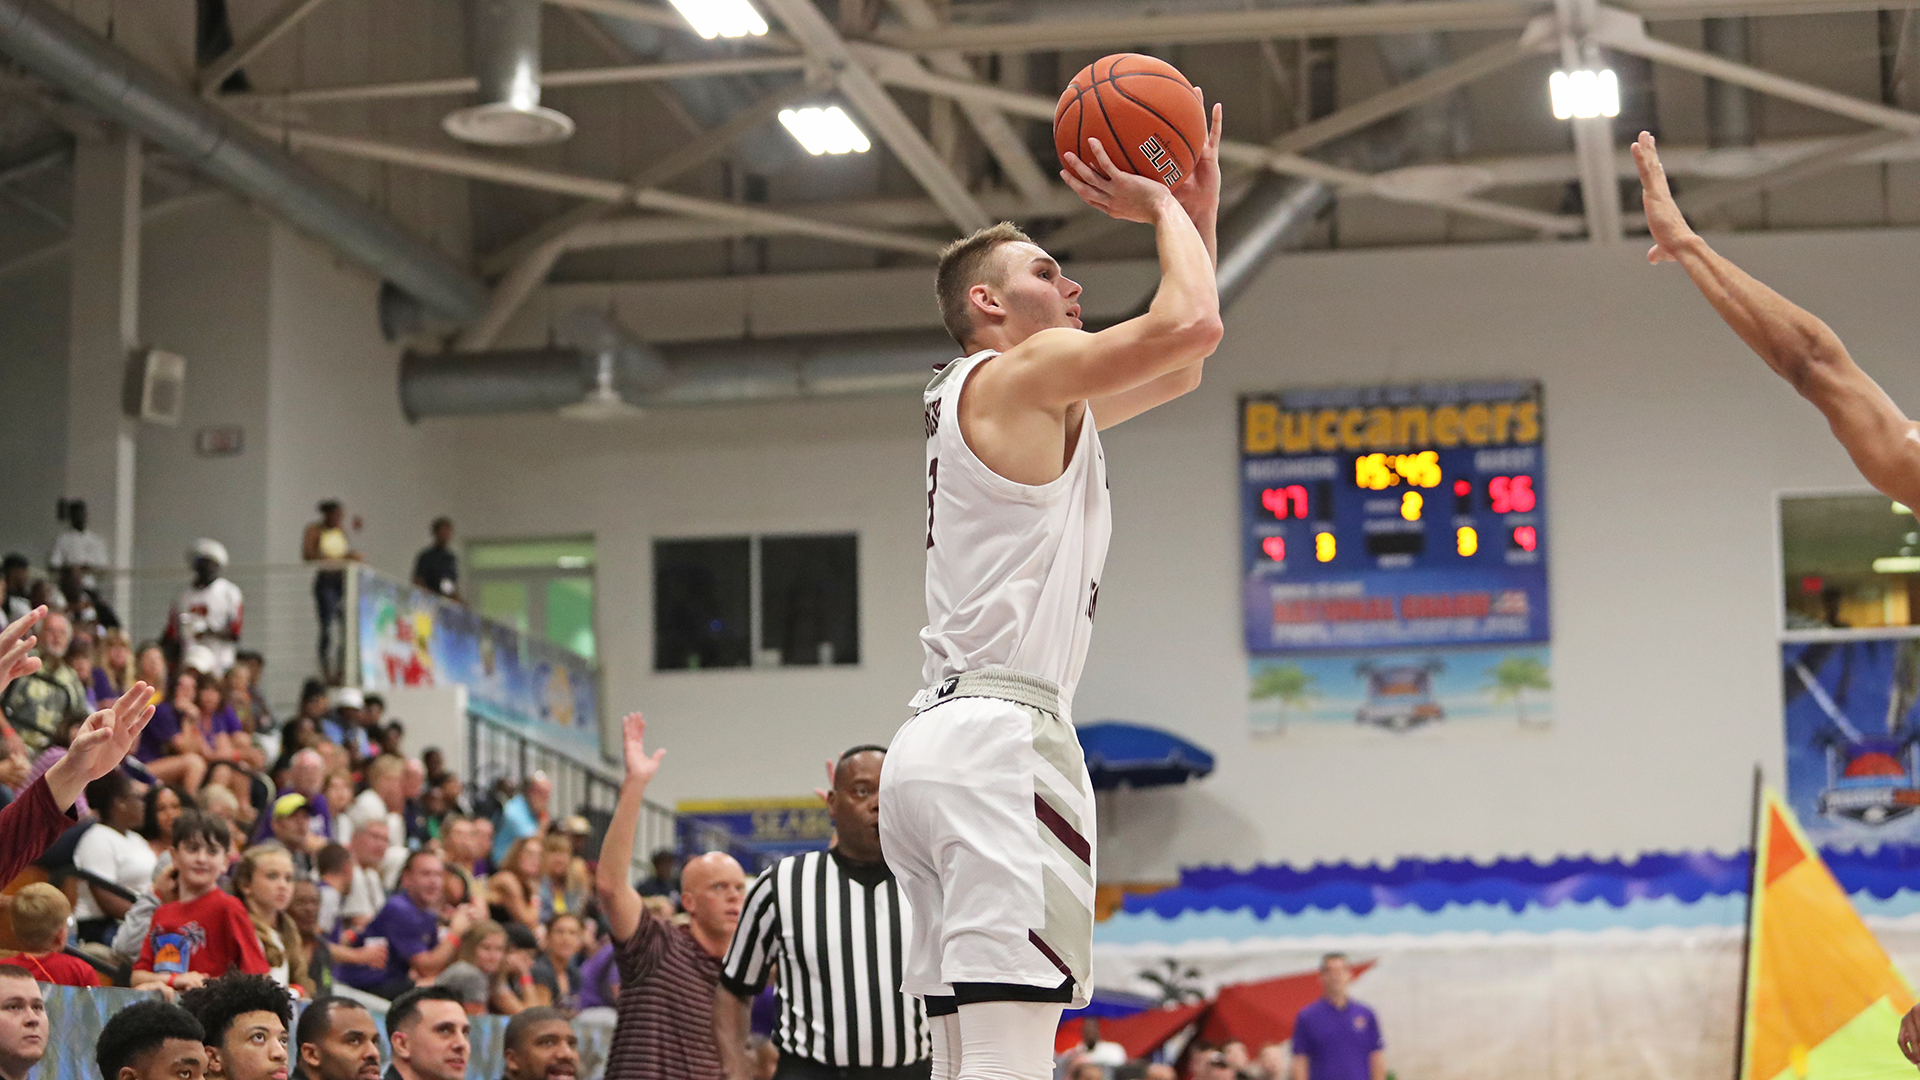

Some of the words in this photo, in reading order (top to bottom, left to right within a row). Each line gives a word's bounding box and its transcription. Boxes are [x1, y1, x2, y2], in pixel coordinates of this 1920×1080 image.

[1245, 402, 1540, 453] Buccaneers
[1356, 450, 1442, 490] 15:45
[1262, 484, 1308, 519] 47
[1488, 475, 1536, 513] 56
